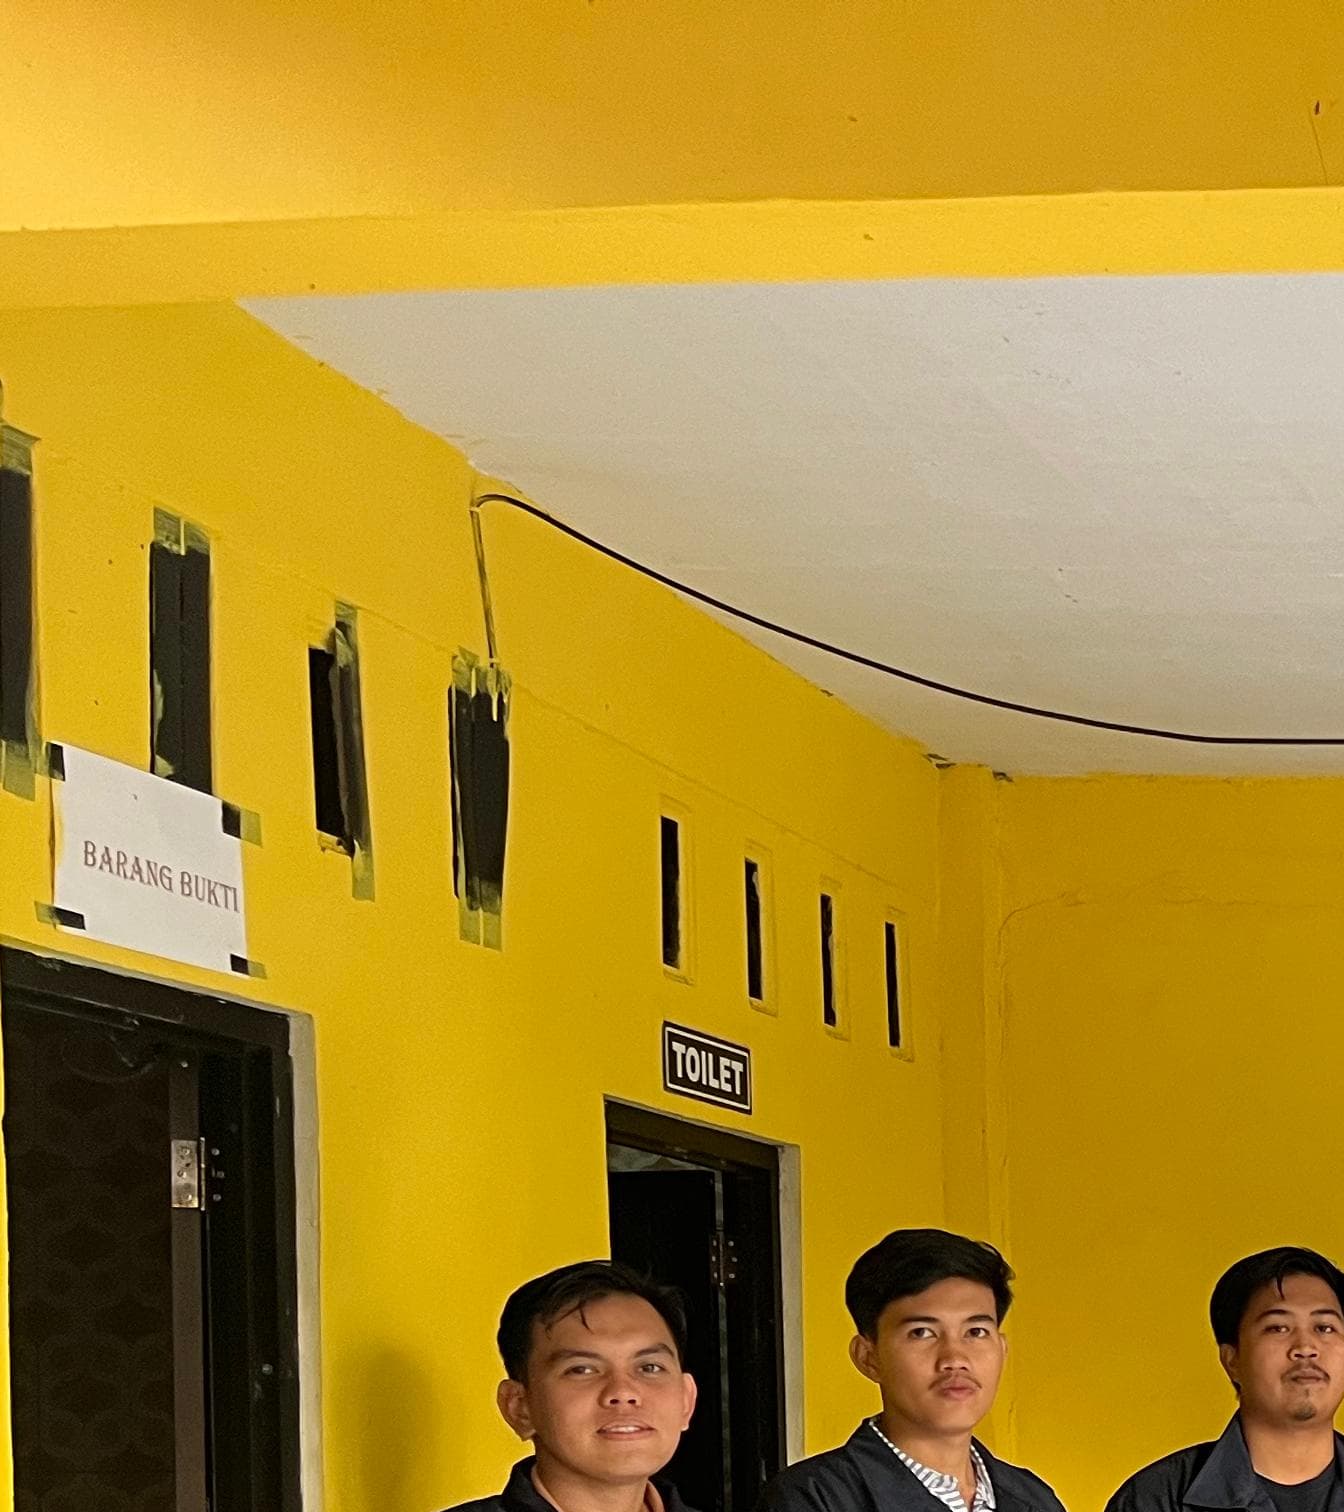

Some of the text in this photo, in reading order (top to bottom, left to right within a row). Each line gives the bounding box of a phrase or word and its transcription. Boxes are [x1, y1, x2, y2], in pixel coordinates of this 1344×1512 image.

[83, 840, 241, 913] BARANG BUKTI
[671, 1041, 743, 1095] TOILET
